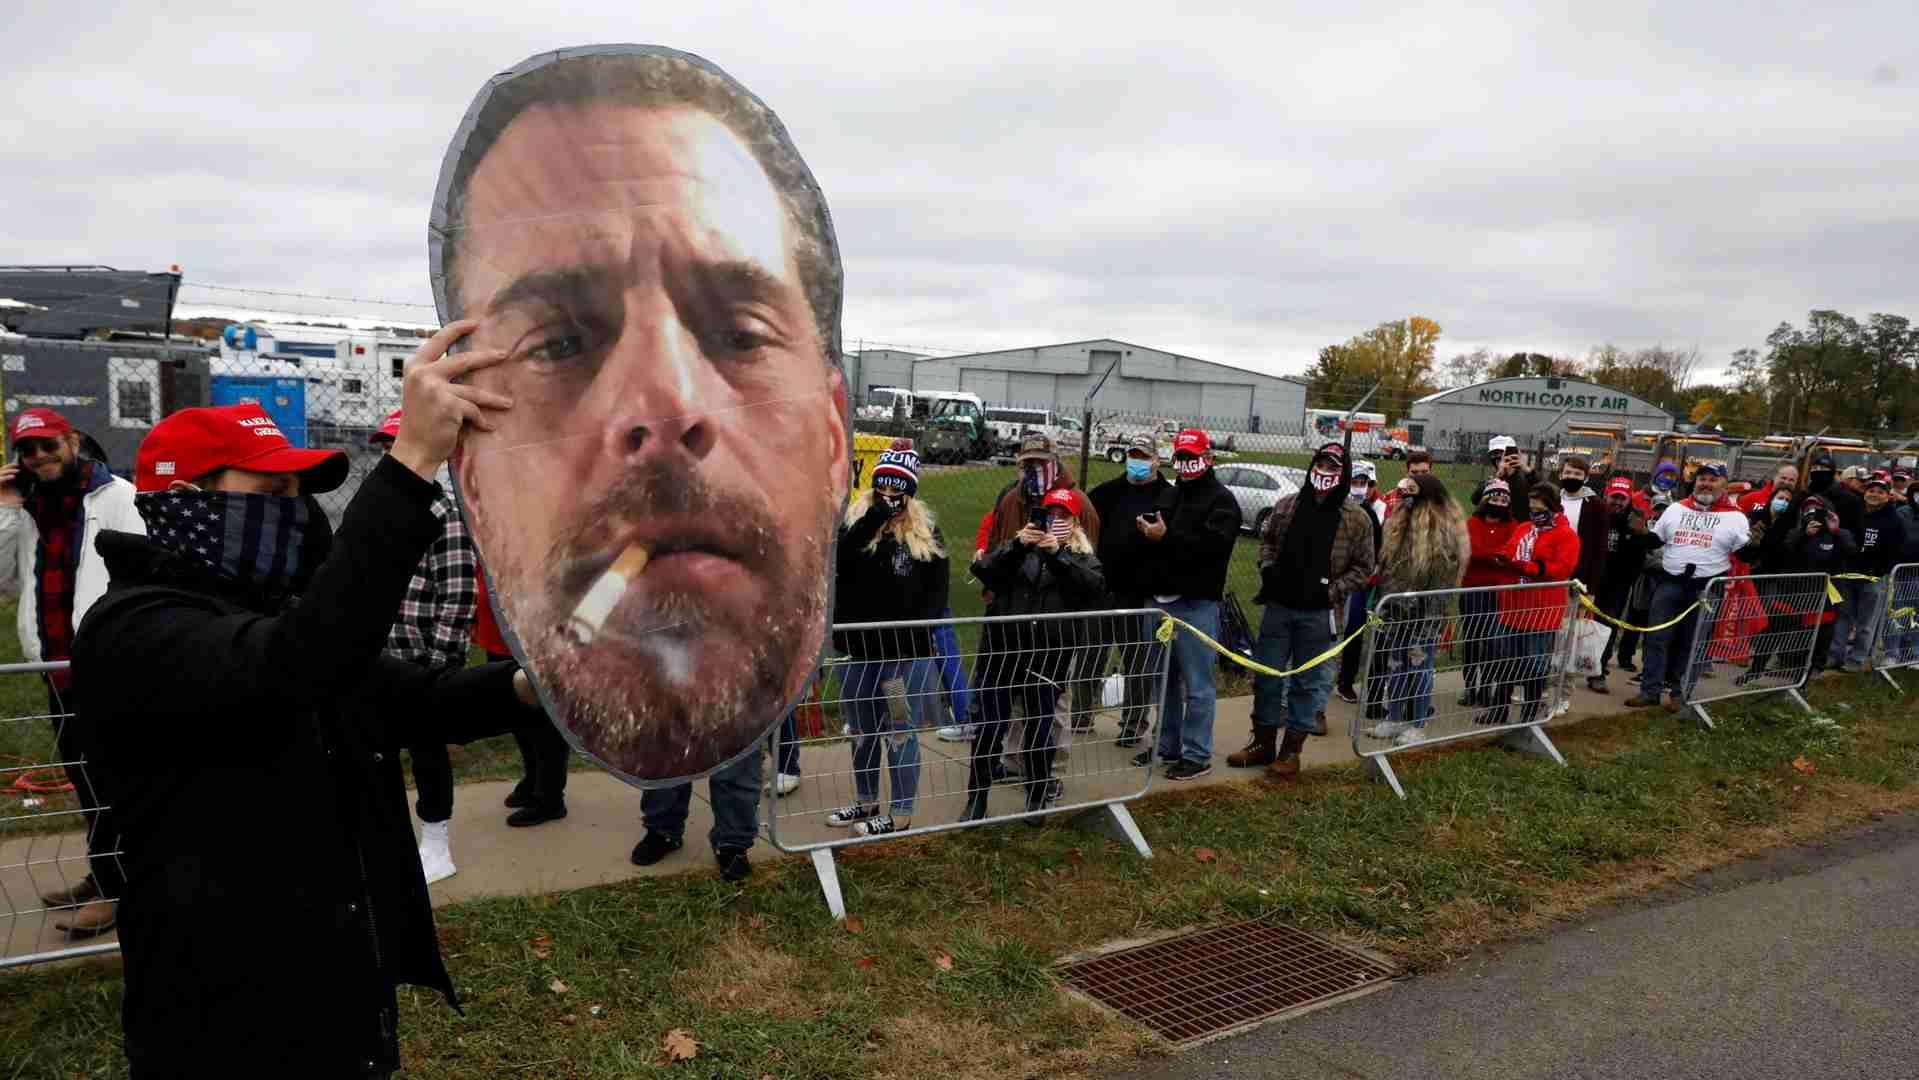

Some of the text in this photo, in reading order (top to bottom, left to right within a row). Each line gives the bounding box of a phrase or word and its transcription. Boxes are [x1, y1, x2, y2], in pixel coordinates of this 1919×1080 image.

[1479, 389, 1629, 409] NORTH COAST AIR
[878, 476, 908, 490] 2020
[1679, 511, 1721, 529] TRUMP
